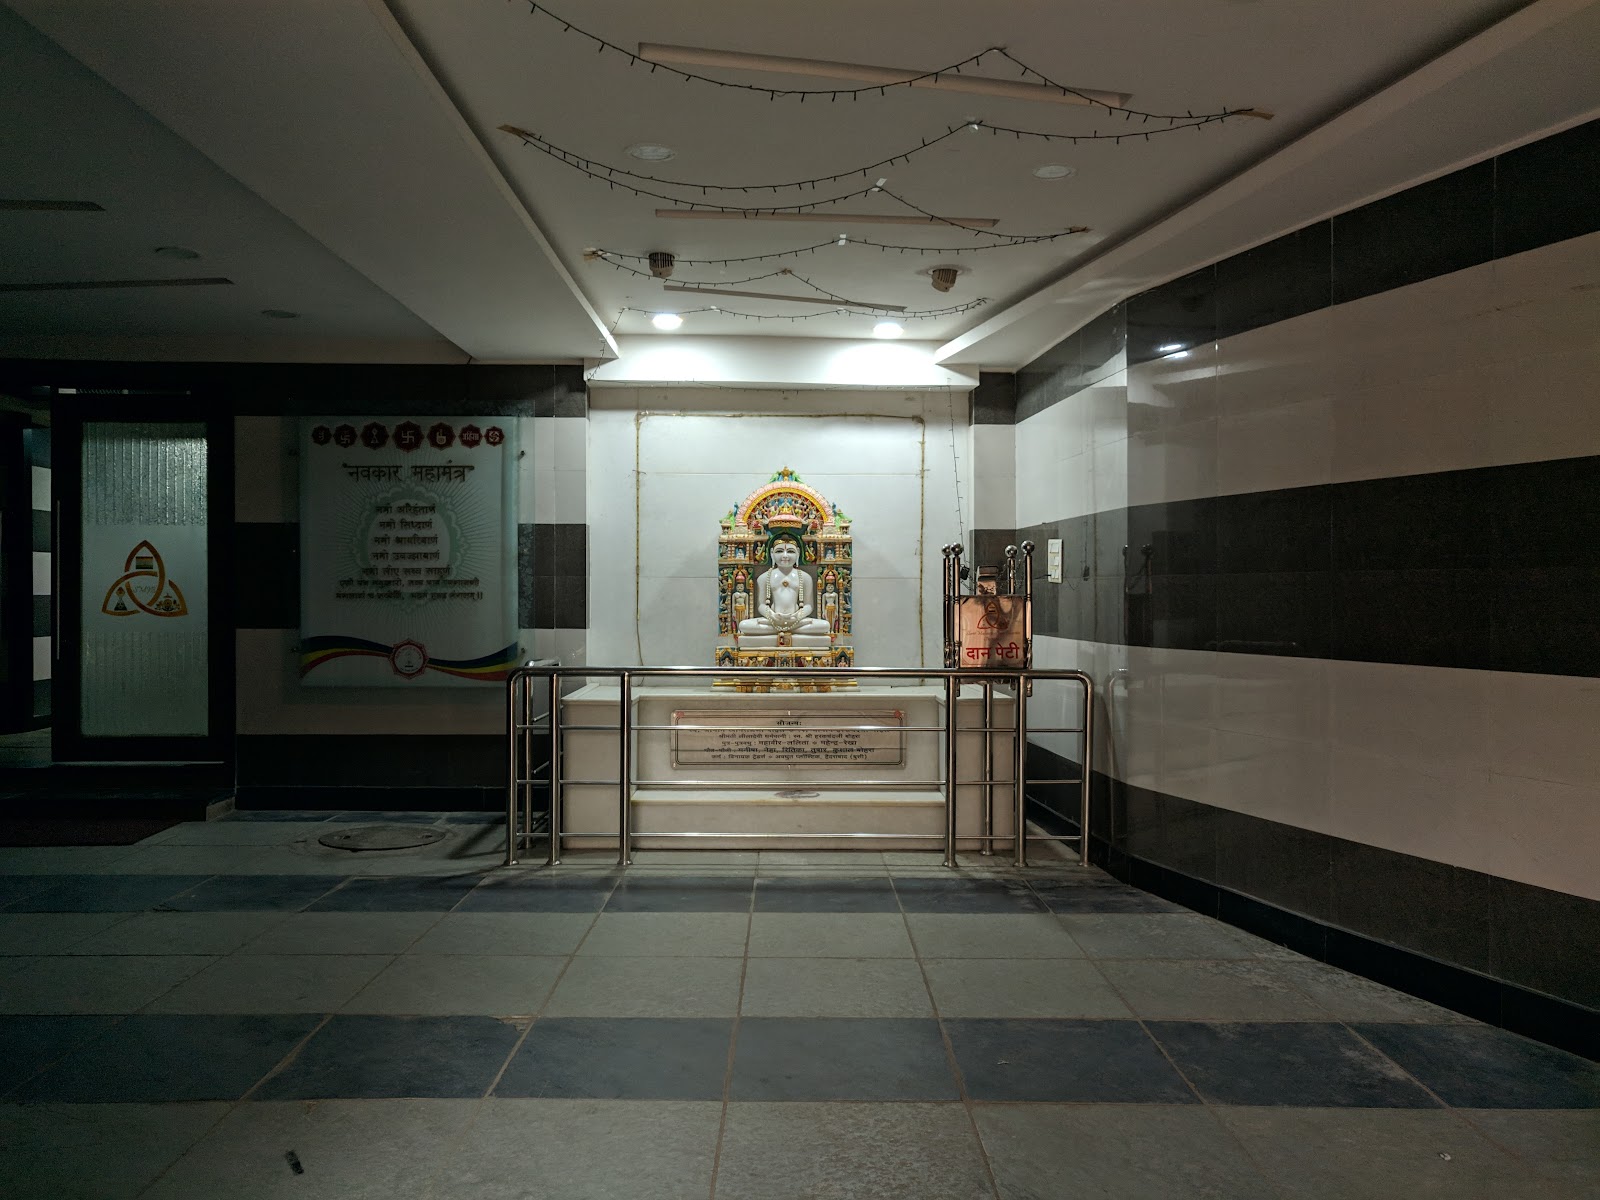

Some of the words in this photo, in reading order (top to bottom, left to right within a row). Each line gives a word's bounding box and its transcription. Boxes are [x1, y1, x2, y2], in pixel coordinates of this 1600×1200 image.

[342, 463, 403, 482] नवकार
[410, 460, 475, 482] महामंत्र
[966, 647, 991, 660] दान
[995, 642, 1019, 659] पेटी
